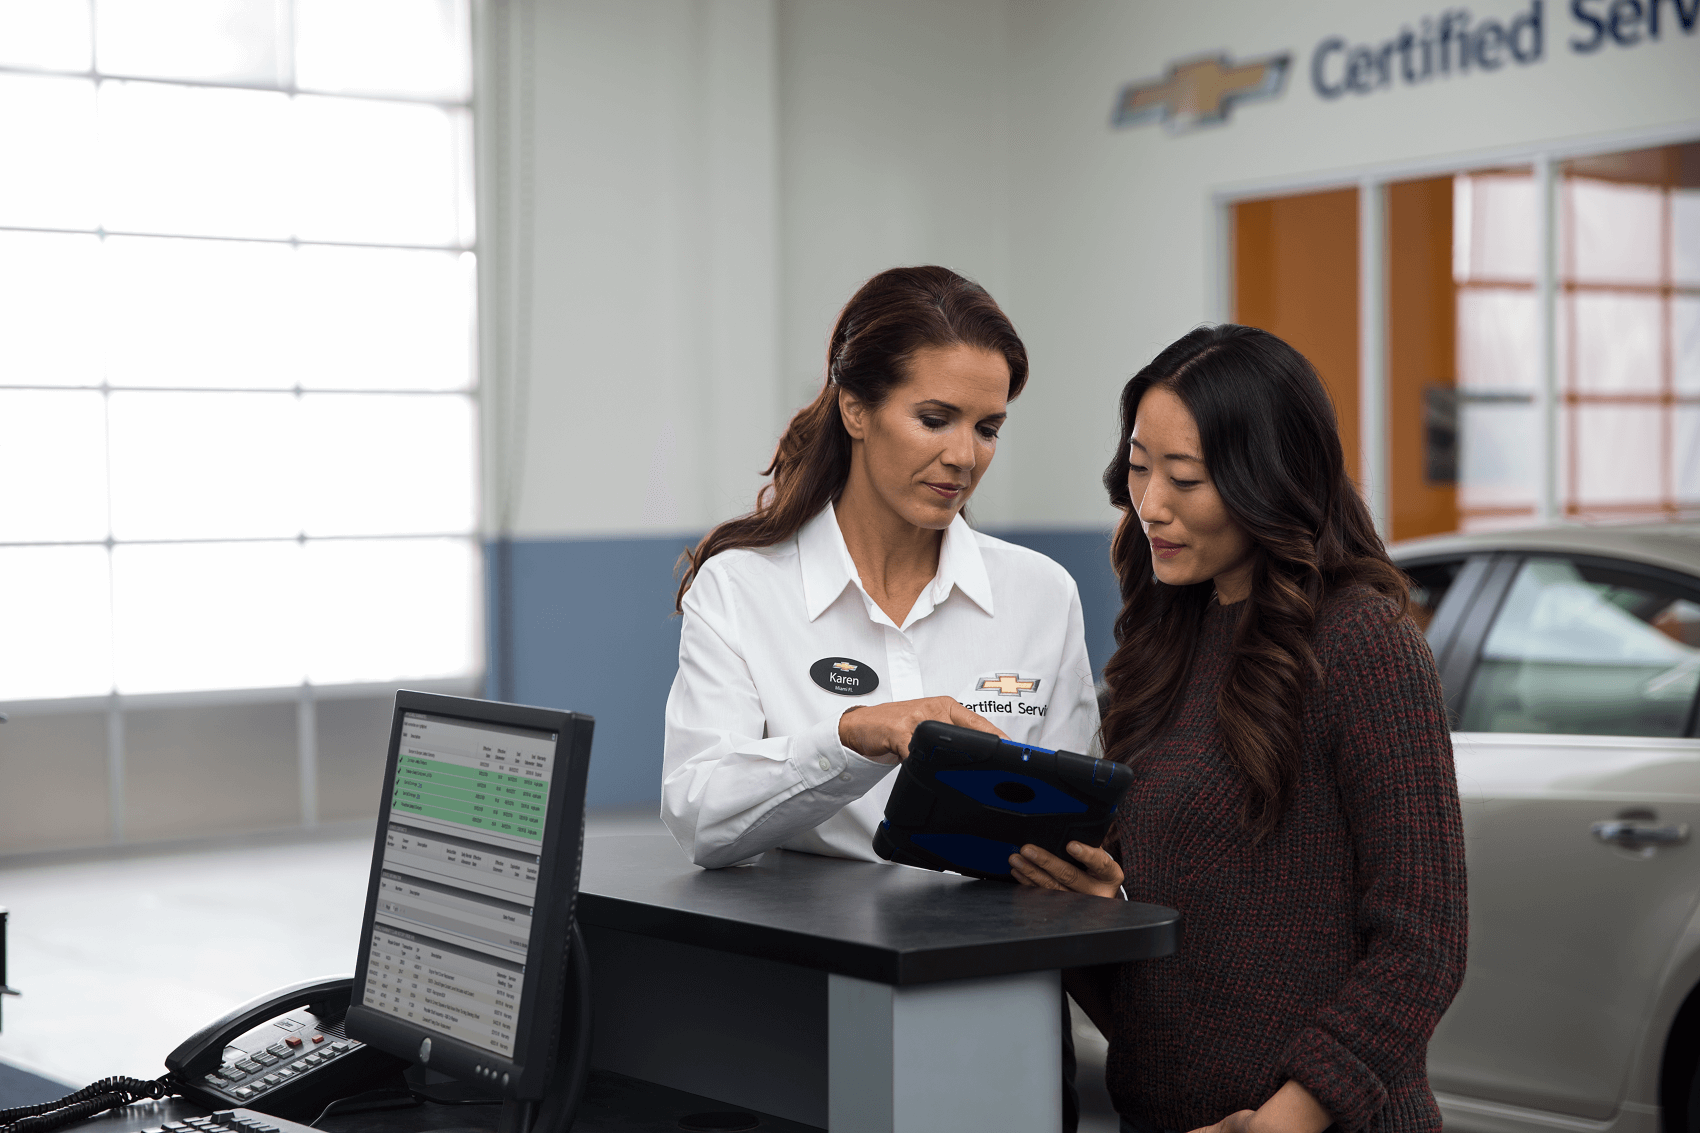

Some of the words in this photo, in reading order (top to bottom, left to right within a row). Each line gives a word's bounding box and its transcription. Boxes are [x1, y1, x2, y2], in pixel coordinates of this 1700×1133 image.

[1310, 0, 1545, 99] Certified
[829, 672, 859, 686] Karen
[958, 701, 1012, 714] ertified
